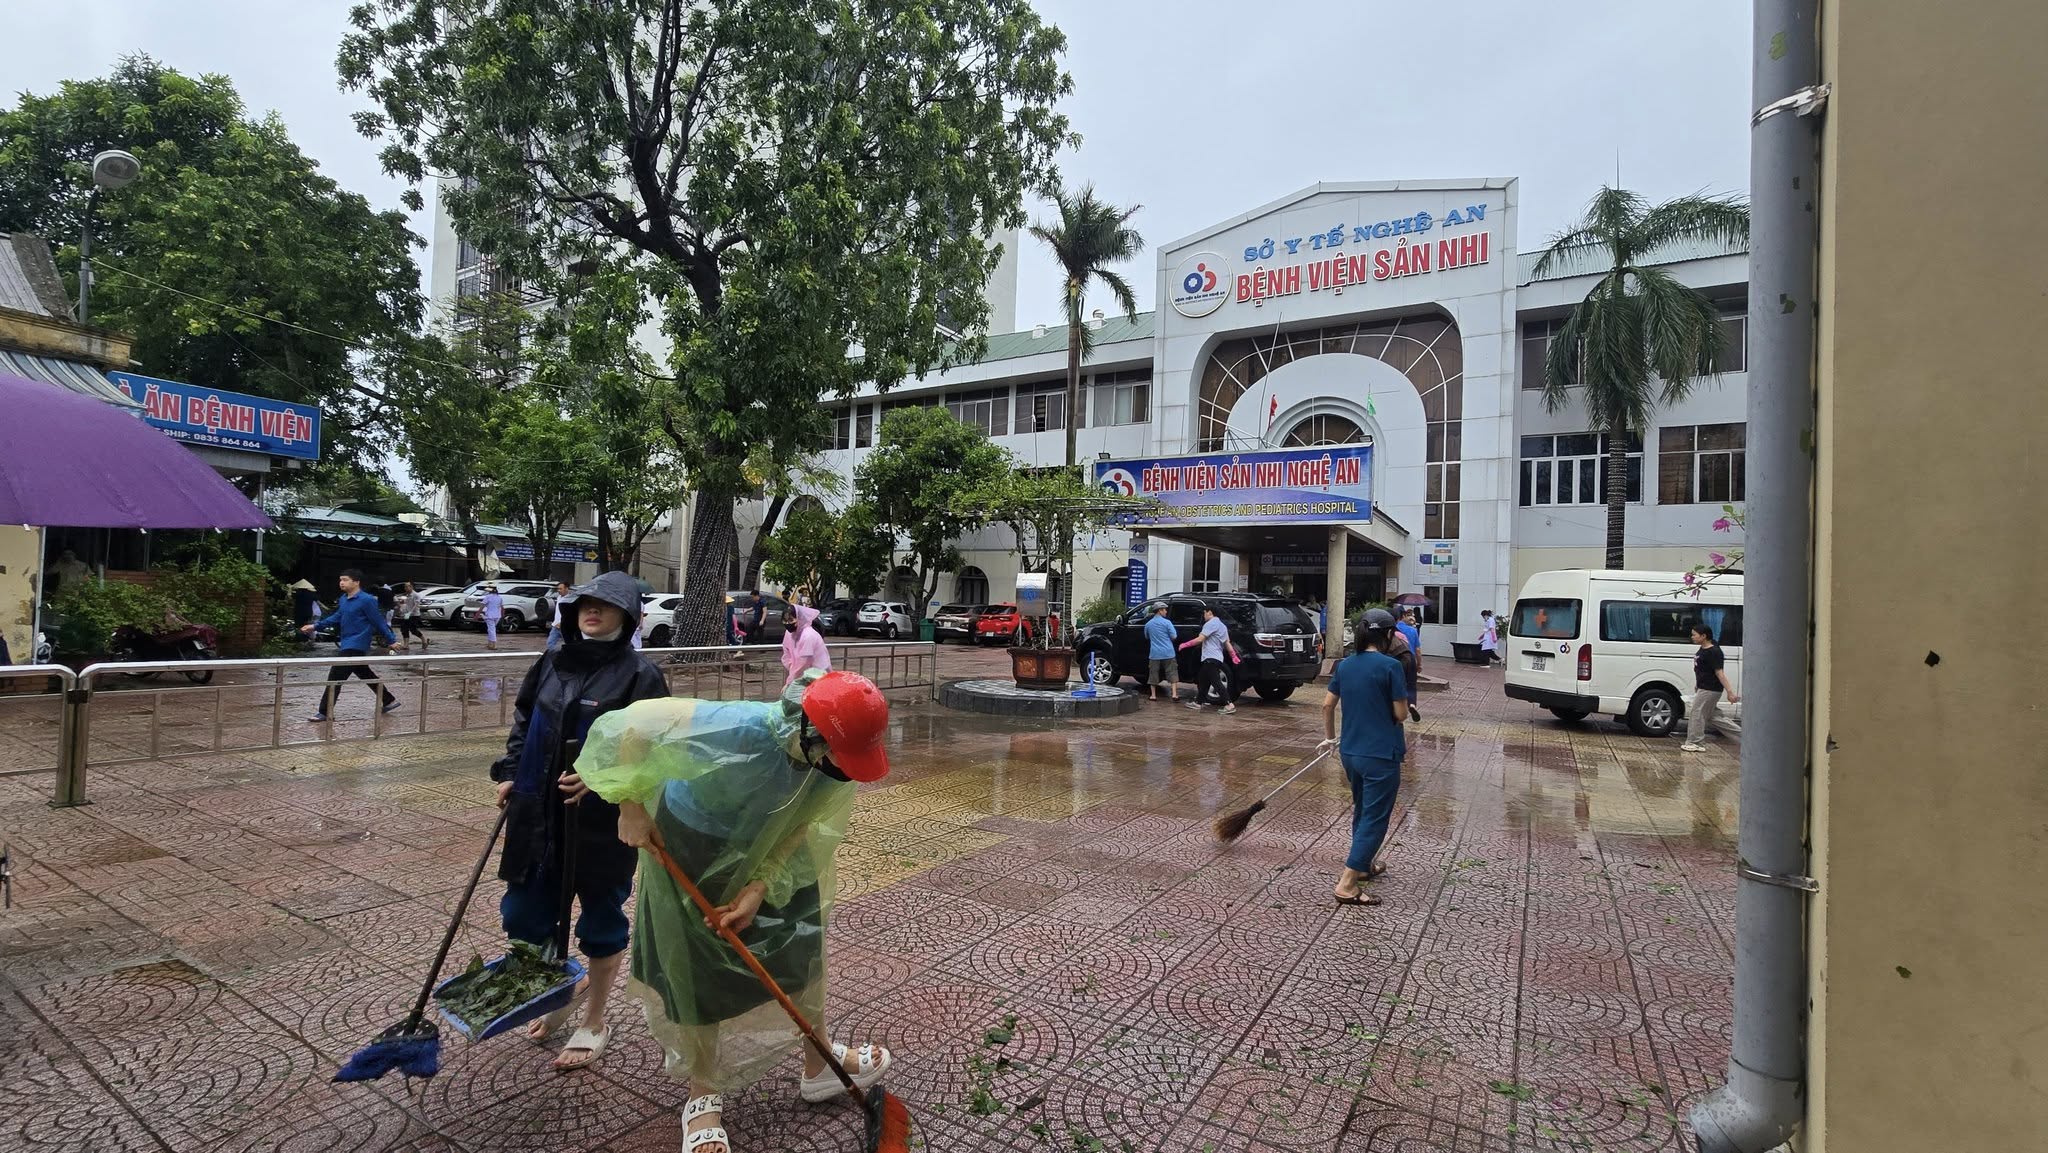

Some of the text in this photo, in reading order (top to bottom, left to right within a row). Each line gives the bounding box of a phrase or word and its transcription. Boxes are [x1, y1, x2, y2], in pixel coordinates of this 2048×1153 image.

[1243, 204, 1487, 262] SỞ Y TẾ NGHỆ AN
[1236, 231, 1490, 307] BỆNH VIỆN SẢN NHI
[144, 383, 182, 423] ĂN
[187, 395, 255, 435] BỆNH
[260, 408, 313, 446] VIỆN
[163, 428, 260, 449] SHIP: 0835 864 864
[1142, 453, 1361, 498] BỆNH VIỆN SẢN NHI NGHỆ AN
[1181, 504, 1233, 518] OBSTETRICS
[1233, 503, 1253, 516] AND
[1255, 502, 1308, 515] PEDIATRICS
[1310, 501, 1358, 515] HOSPITAL
